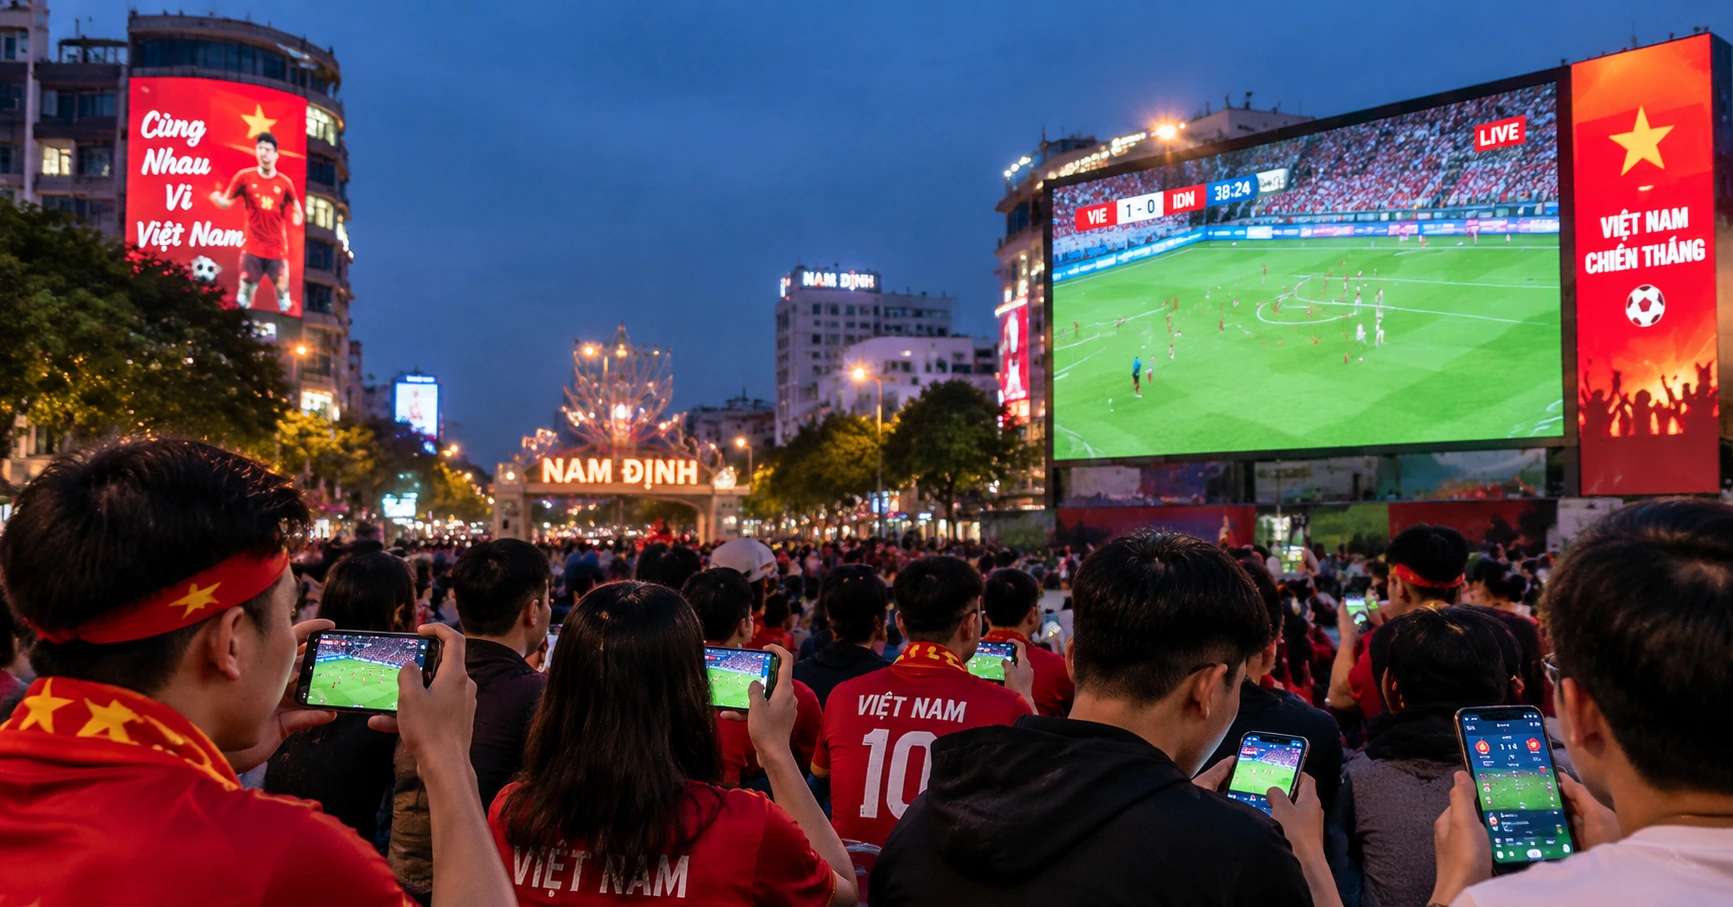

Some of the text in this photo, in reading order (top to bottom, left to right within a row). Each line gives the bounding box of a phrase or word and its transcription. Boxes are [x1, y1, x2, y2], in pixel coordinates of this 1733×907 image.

[1480, 122, 1519, 147] LIVE
[140, 147, 212, 176] Nhau
[1087, 207, 1108, 225] VIE
[1126, 203, 1131, 218] 1
[1147, 199, 1155, 214] 0
[1172, 190, 1196, 210] IDN
[1214, 180, 1252, 201] 38:24
[137, 220, 246, 252] Việt Nam
[1600, 206, 1689, 241] VIỆT NAM
[803, 271, 837, 287] NAM
[542, 458, 698, 490] NAM ĐỊNH
[858, 691, 967, 723] VIỆT NAM
[860, 728, 937, 819] 10
[514, 839, 690, 898] VIỆT NAM
